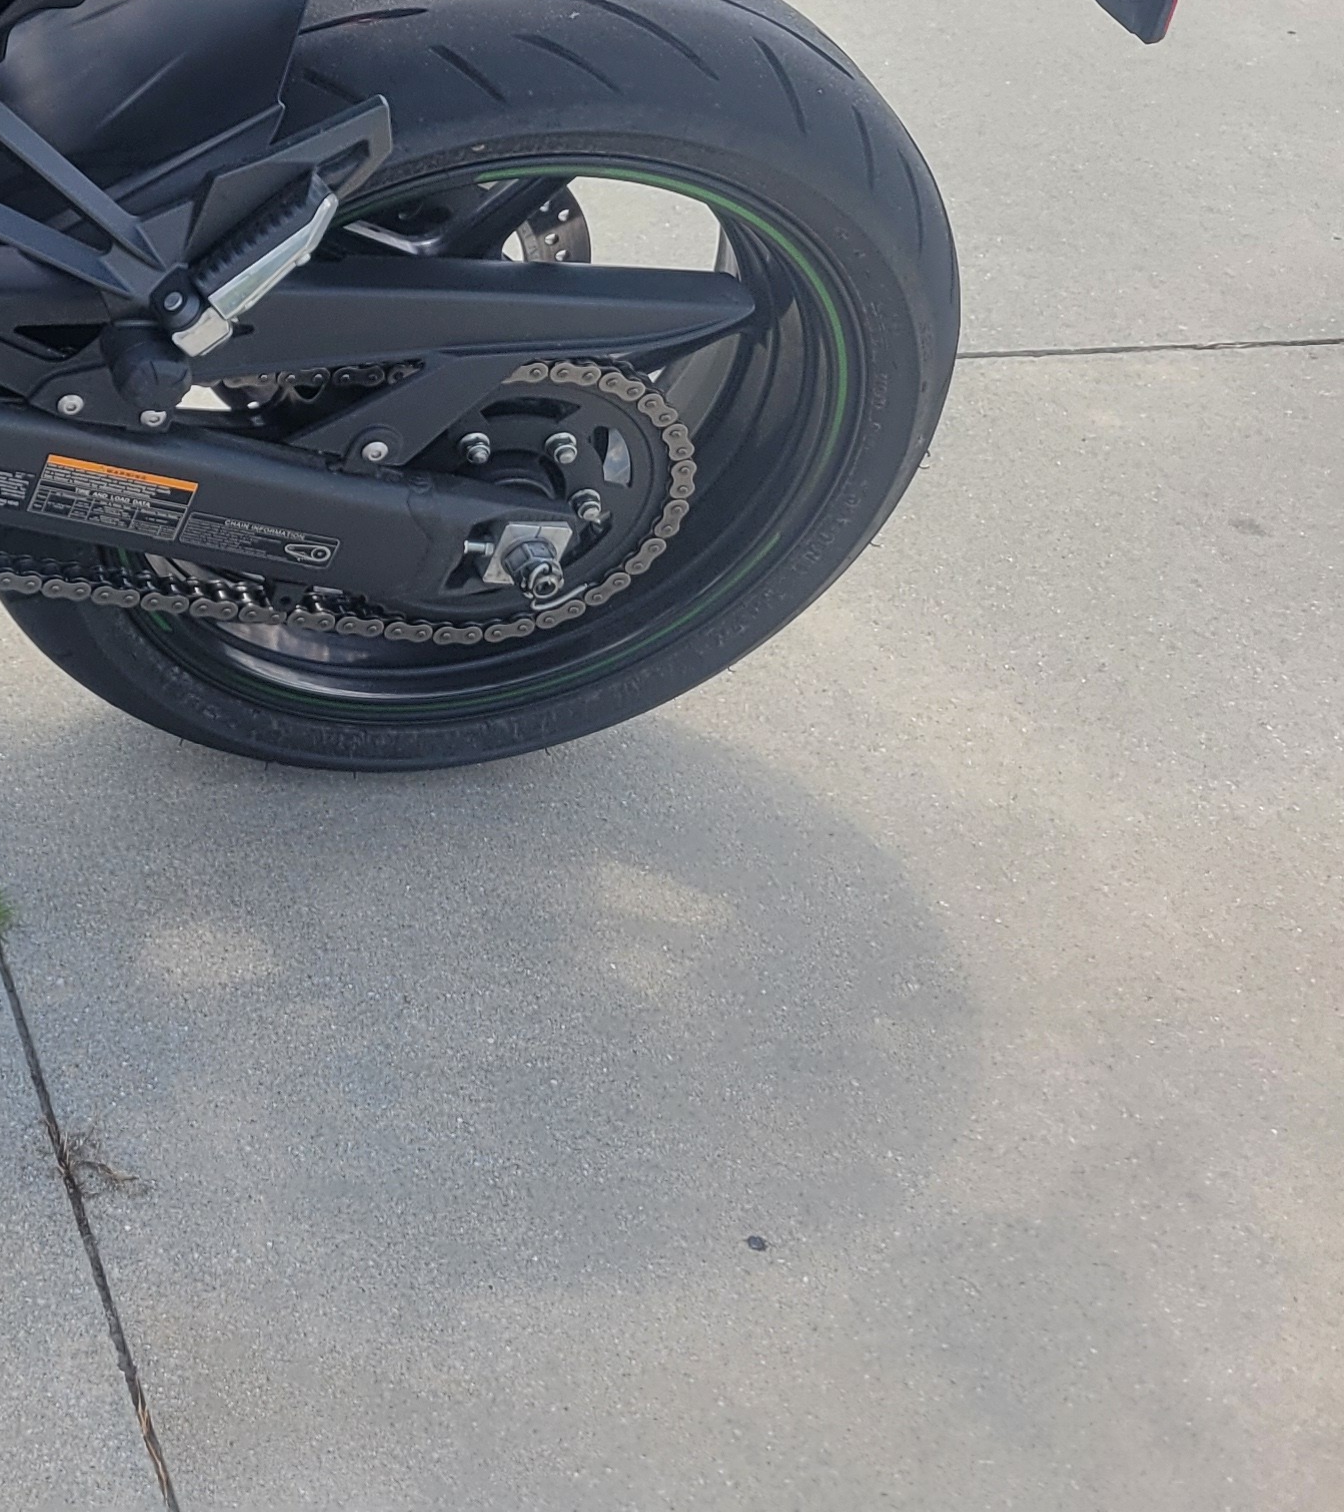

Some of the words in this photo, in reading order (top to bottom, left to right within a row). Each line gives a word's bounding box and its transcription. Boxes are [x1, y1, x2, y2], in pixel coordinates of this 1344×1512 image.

[92, 491, 108, 499] AND
[110, 494, 131, 504] LOAD
[132, 499, 151, 508] DATA
[224, 519, 250, 530] CHAIN
[251, 524, 306, 541] INFORMATION
